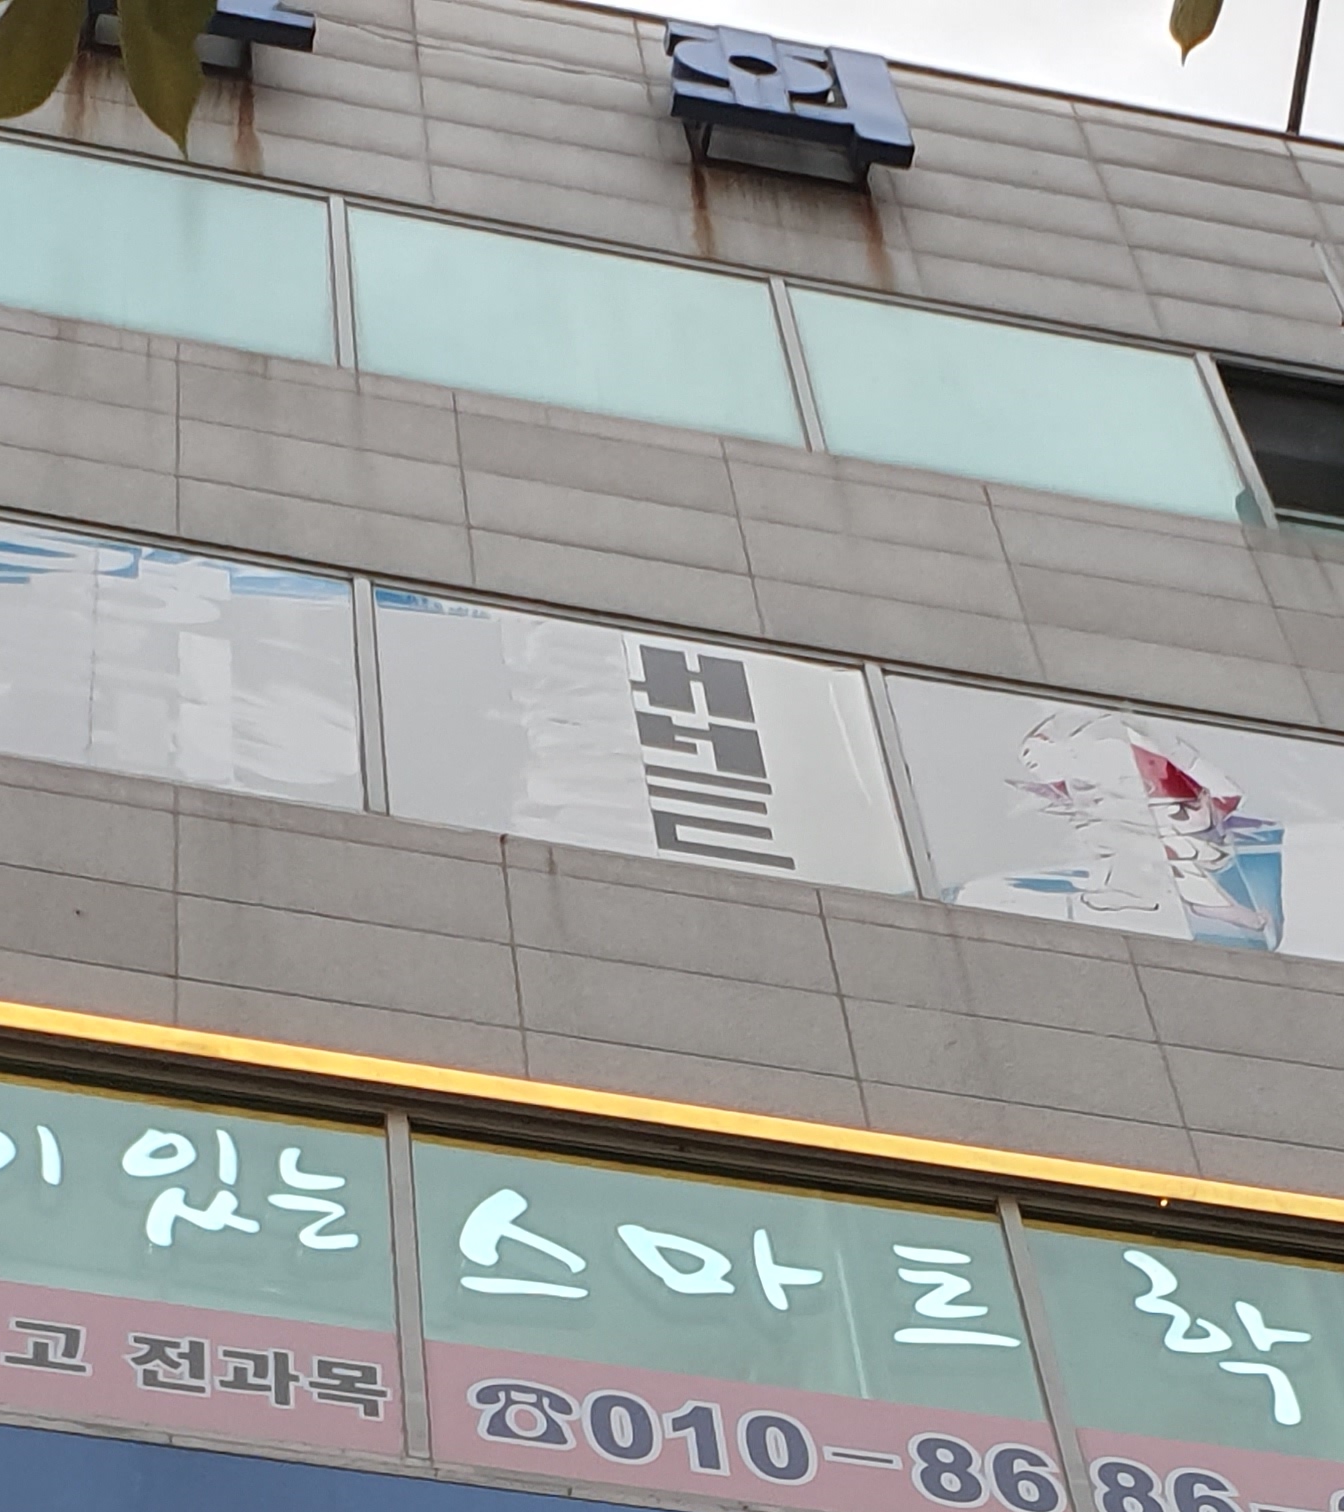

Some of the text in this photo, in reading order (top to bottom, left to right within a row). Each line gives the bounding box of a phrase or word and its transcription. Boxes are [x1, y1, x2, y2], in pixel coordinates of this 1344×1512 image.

[120, 1126, 362, 1251] 있는
[459, 1188, 1022, 1349] 스마트
[126, 1328, 390, 1422] 전과목
